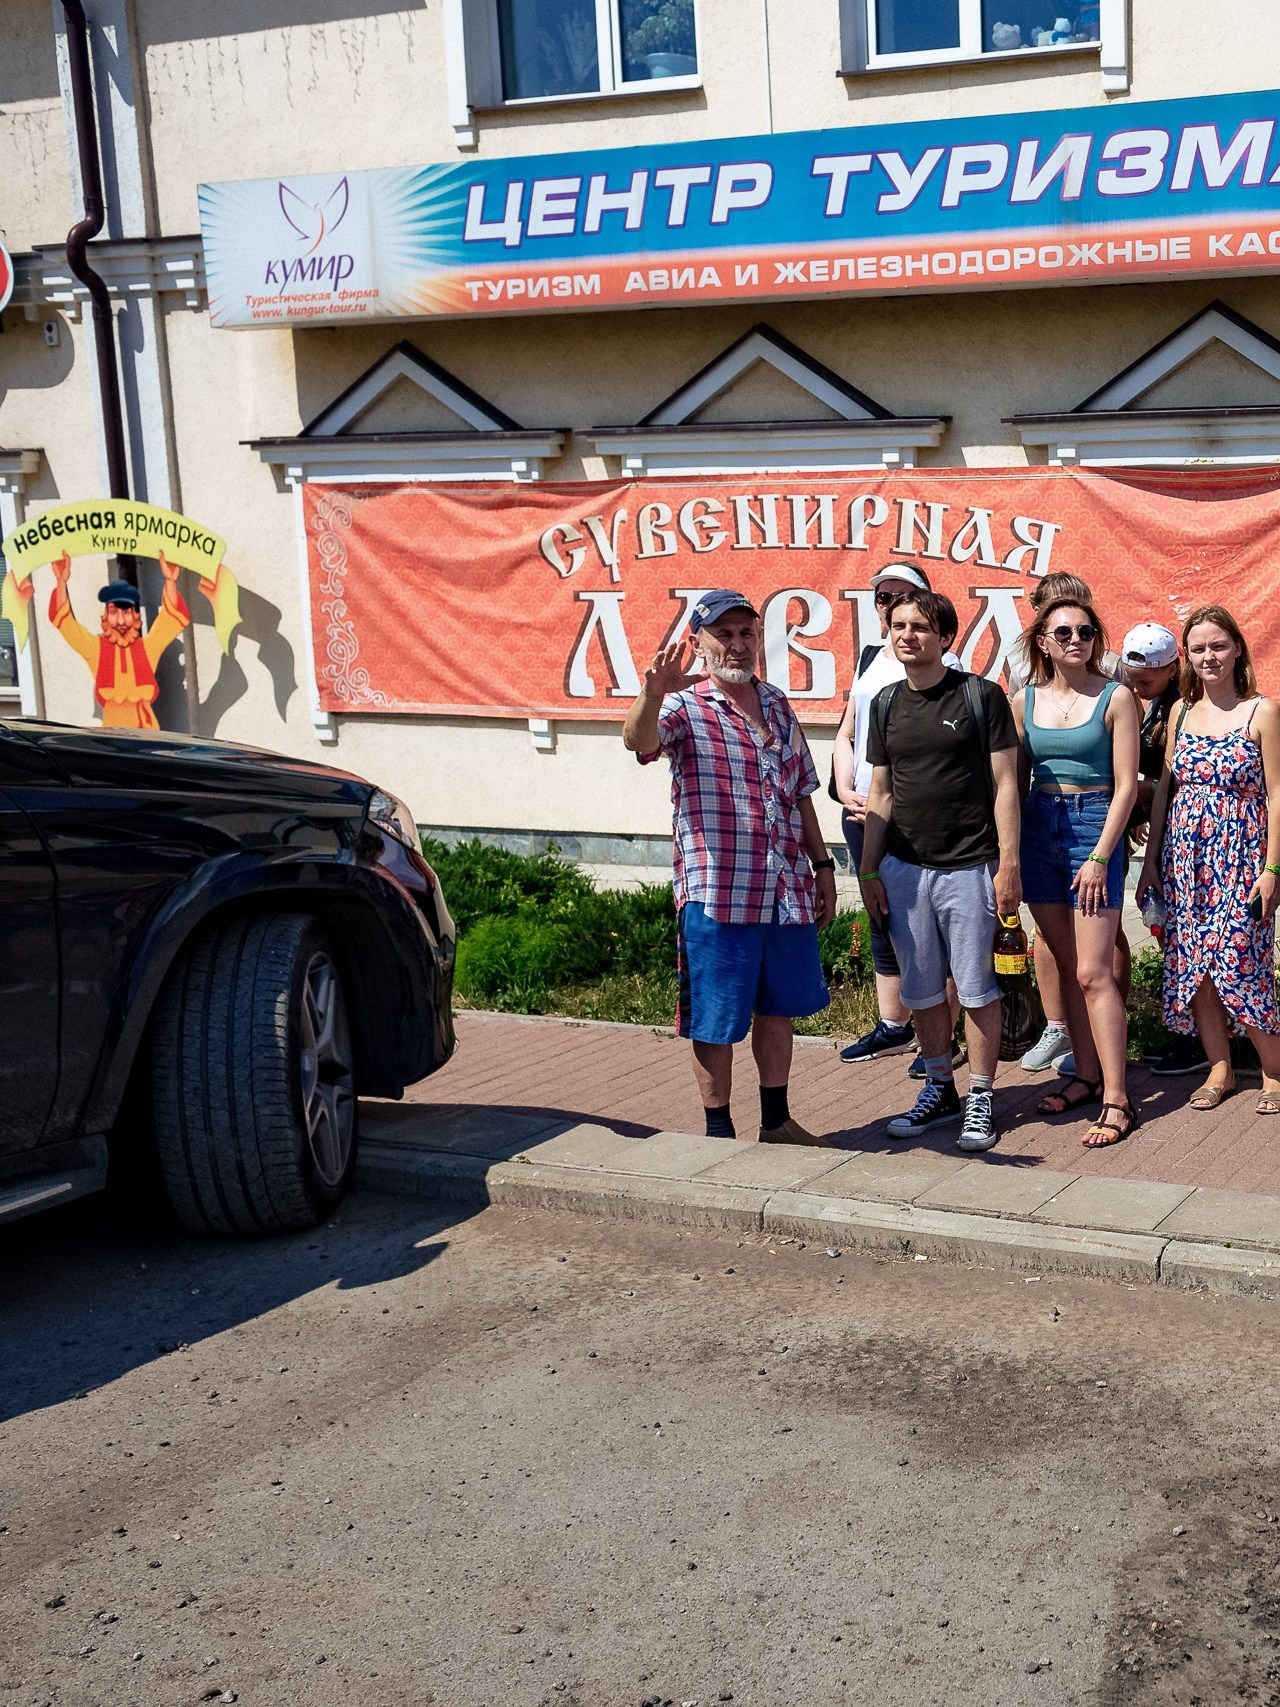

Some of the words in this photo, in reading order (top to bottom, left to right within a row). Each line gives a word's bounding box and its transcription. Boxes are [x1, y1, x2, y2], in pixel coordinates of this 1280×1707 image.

[462, 160, 775, 248] ЦЕНТР
[465, 273, 602, 302] ТУРИЗМ
[624, 267, 723, 293] АВИА
[734, 264, 760, 286] И
[773, 236, 1192, 284] ЖЕЛЕЗНОДОРОЖНЫЕ
[246, 292, 331, 306] Туристическая
[338, 288, 380, 301] фирма
[14, 511, 116, 553] небесная
[124, 512, 217, 556] ярмарка
[91, 534, 138, 552] Кунгур
